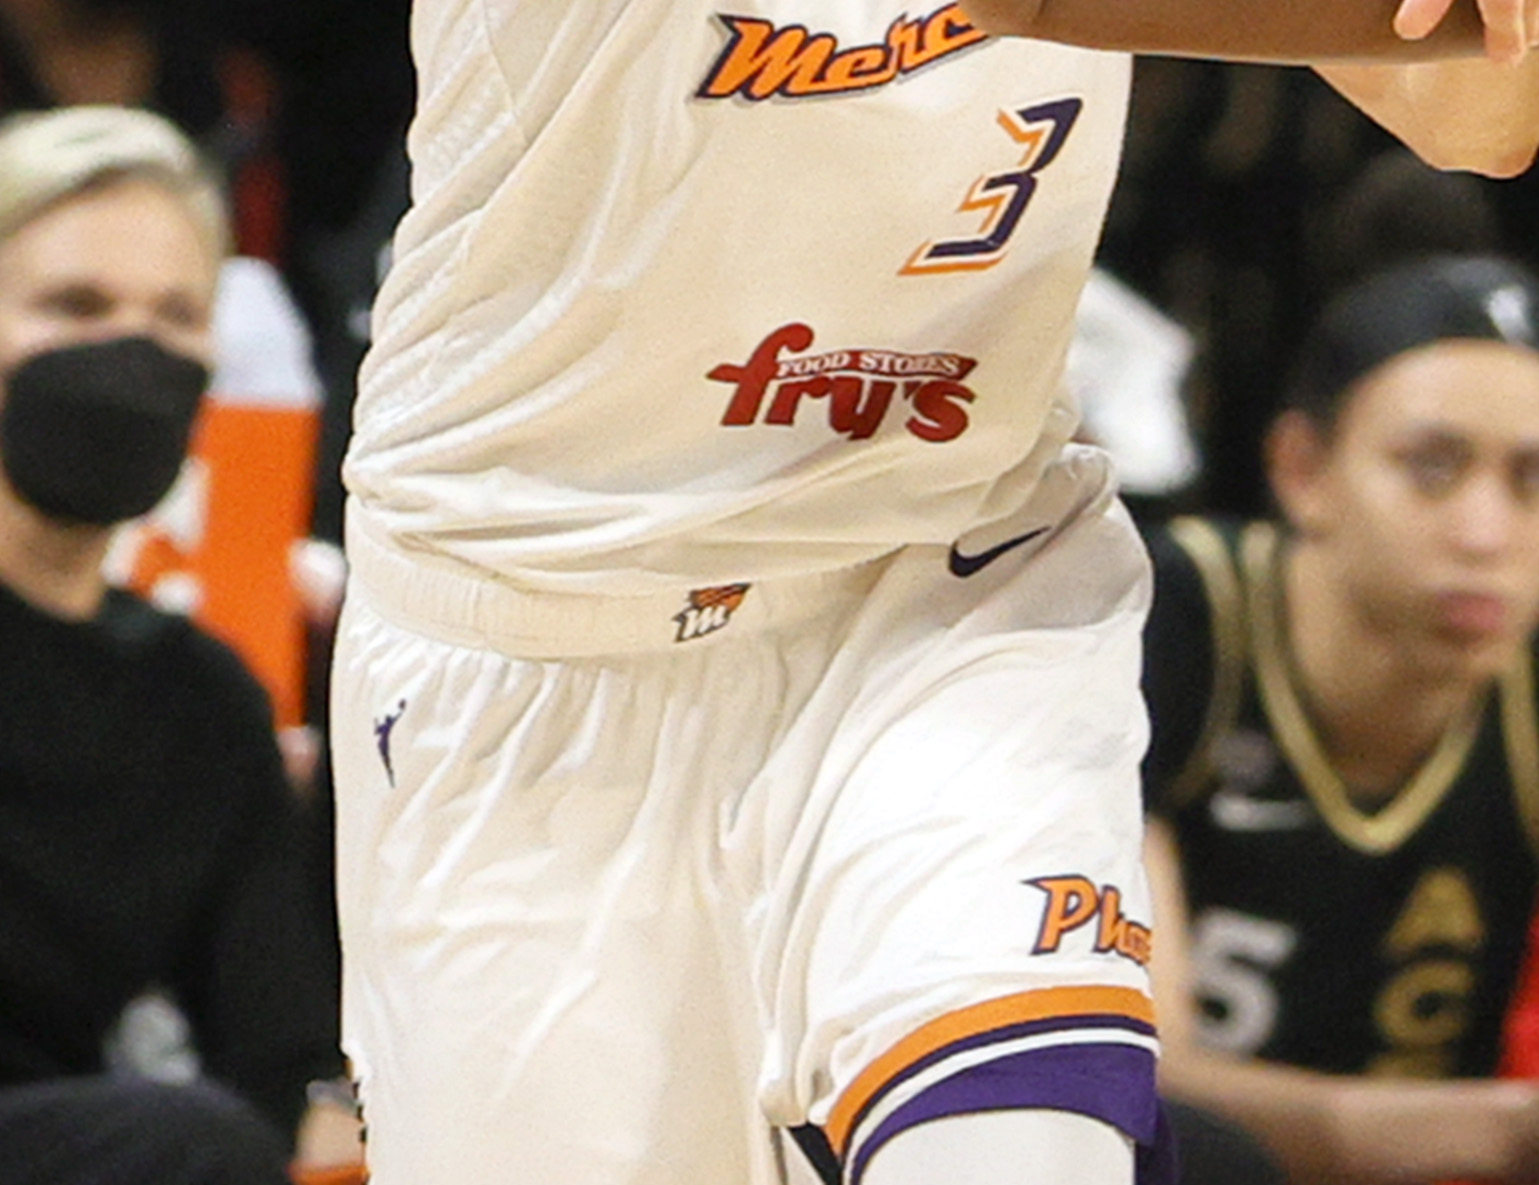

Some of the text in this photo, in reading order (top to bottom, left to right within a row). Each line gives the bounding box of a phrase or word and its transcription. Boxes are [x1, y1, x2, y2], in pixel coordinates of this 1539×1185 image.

[898, 97, 1083, 276] 3
[776, 352, 850, 377] FOOD
[1195, 908, 1298, 1056] 5
